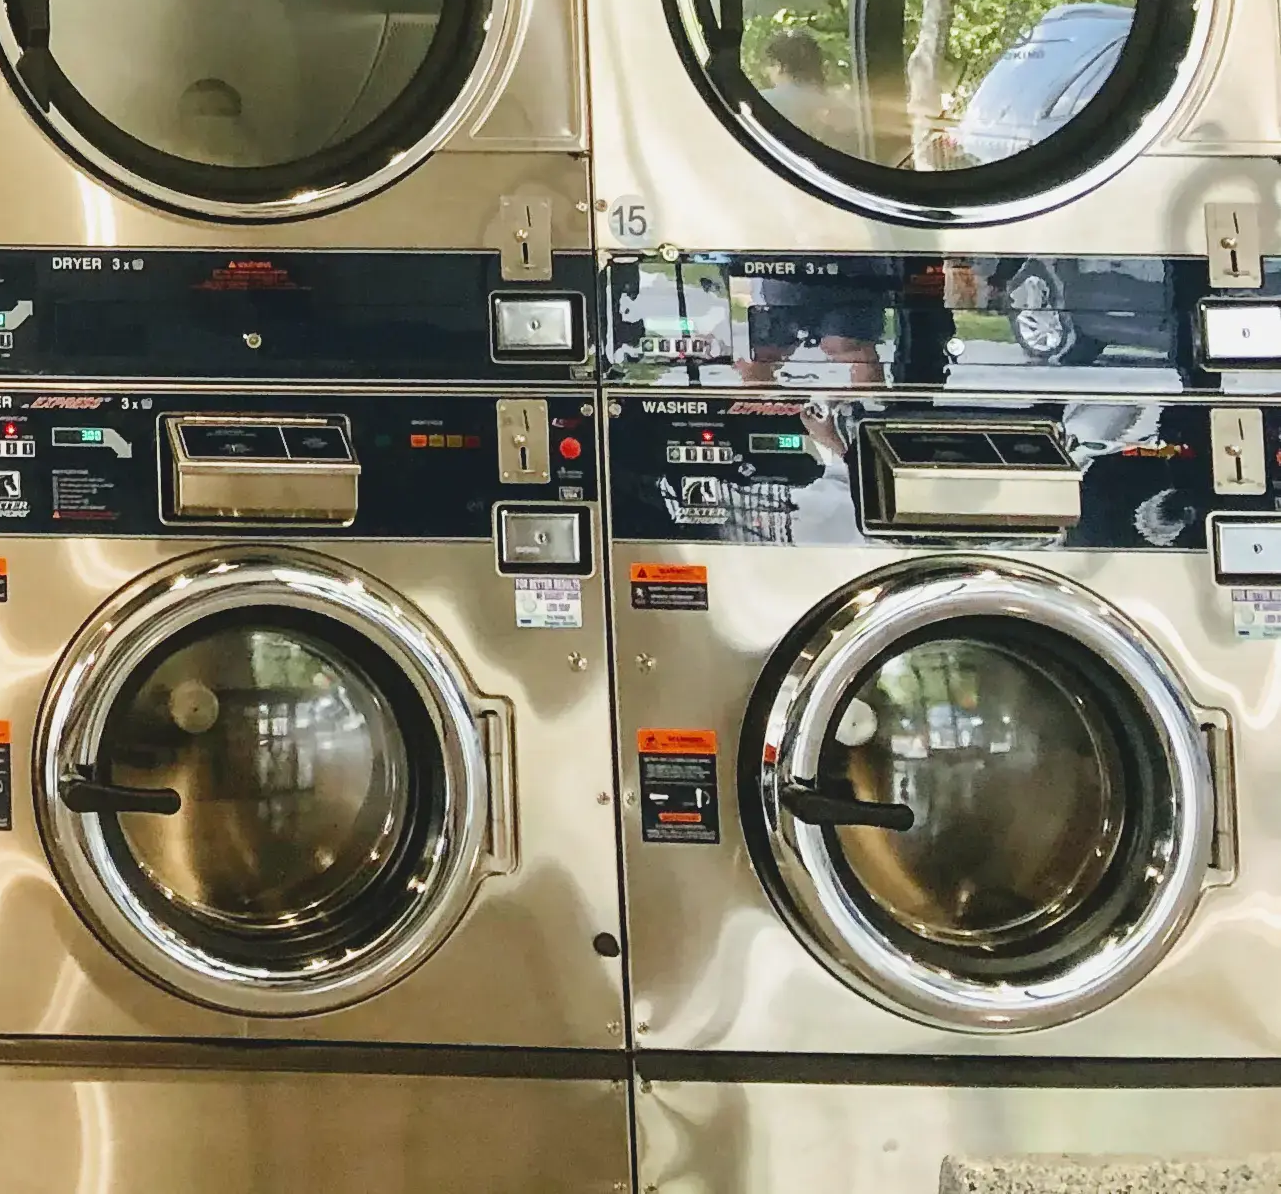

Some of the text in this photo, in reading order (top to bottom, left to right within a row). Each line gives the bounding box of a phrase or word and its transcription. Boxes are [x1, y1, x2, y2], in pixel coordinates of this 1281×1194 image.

[612, 205, 647, 236] 15
[52, 258, 102, 270] DRYER
[744, 262, 796, 274] DRYER
[642, 401, 708, 414] WASHER
[675, 507, 726, 517] DEXTER
